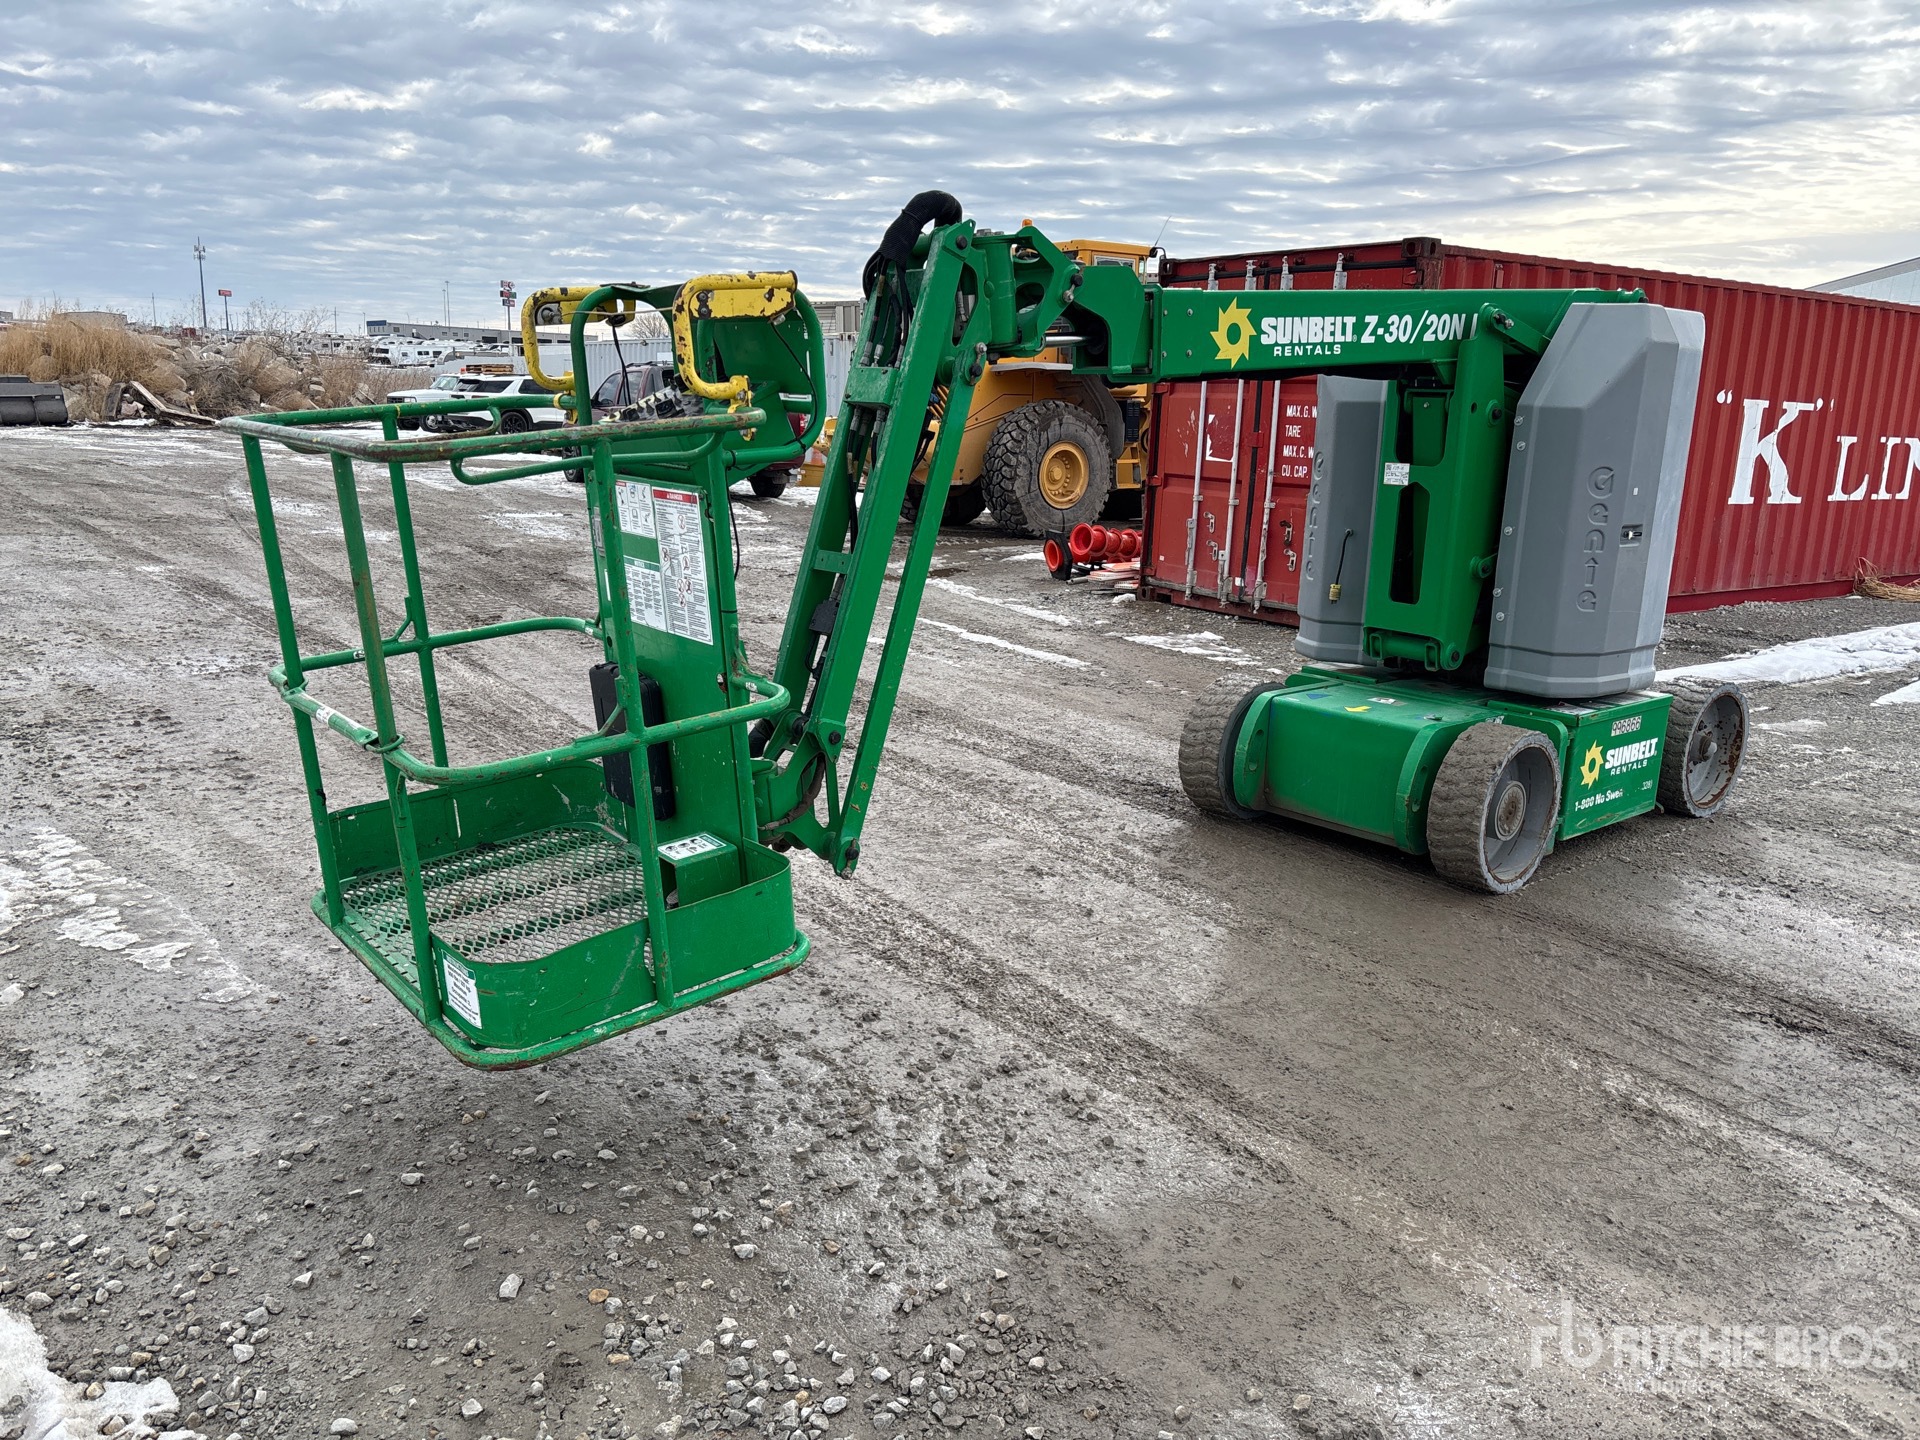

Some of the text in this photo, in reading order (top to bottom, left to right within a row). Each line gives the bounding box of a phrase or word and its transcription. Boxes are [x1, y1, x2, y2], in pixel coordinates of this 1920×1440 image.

[1260, 316, 1356, 345] SUNBELT
[1360, 310, 1466, 344] Z-30/20N
[1273, 344, 1342, 357] RENTALS
[1285, 425, 1301, 438] TARE
[1605, 738, 1658, 770] SUNBELT
[1610, 759, 1648, 777] RENTALS
[1575, 795, 1595, 812] 1-800
